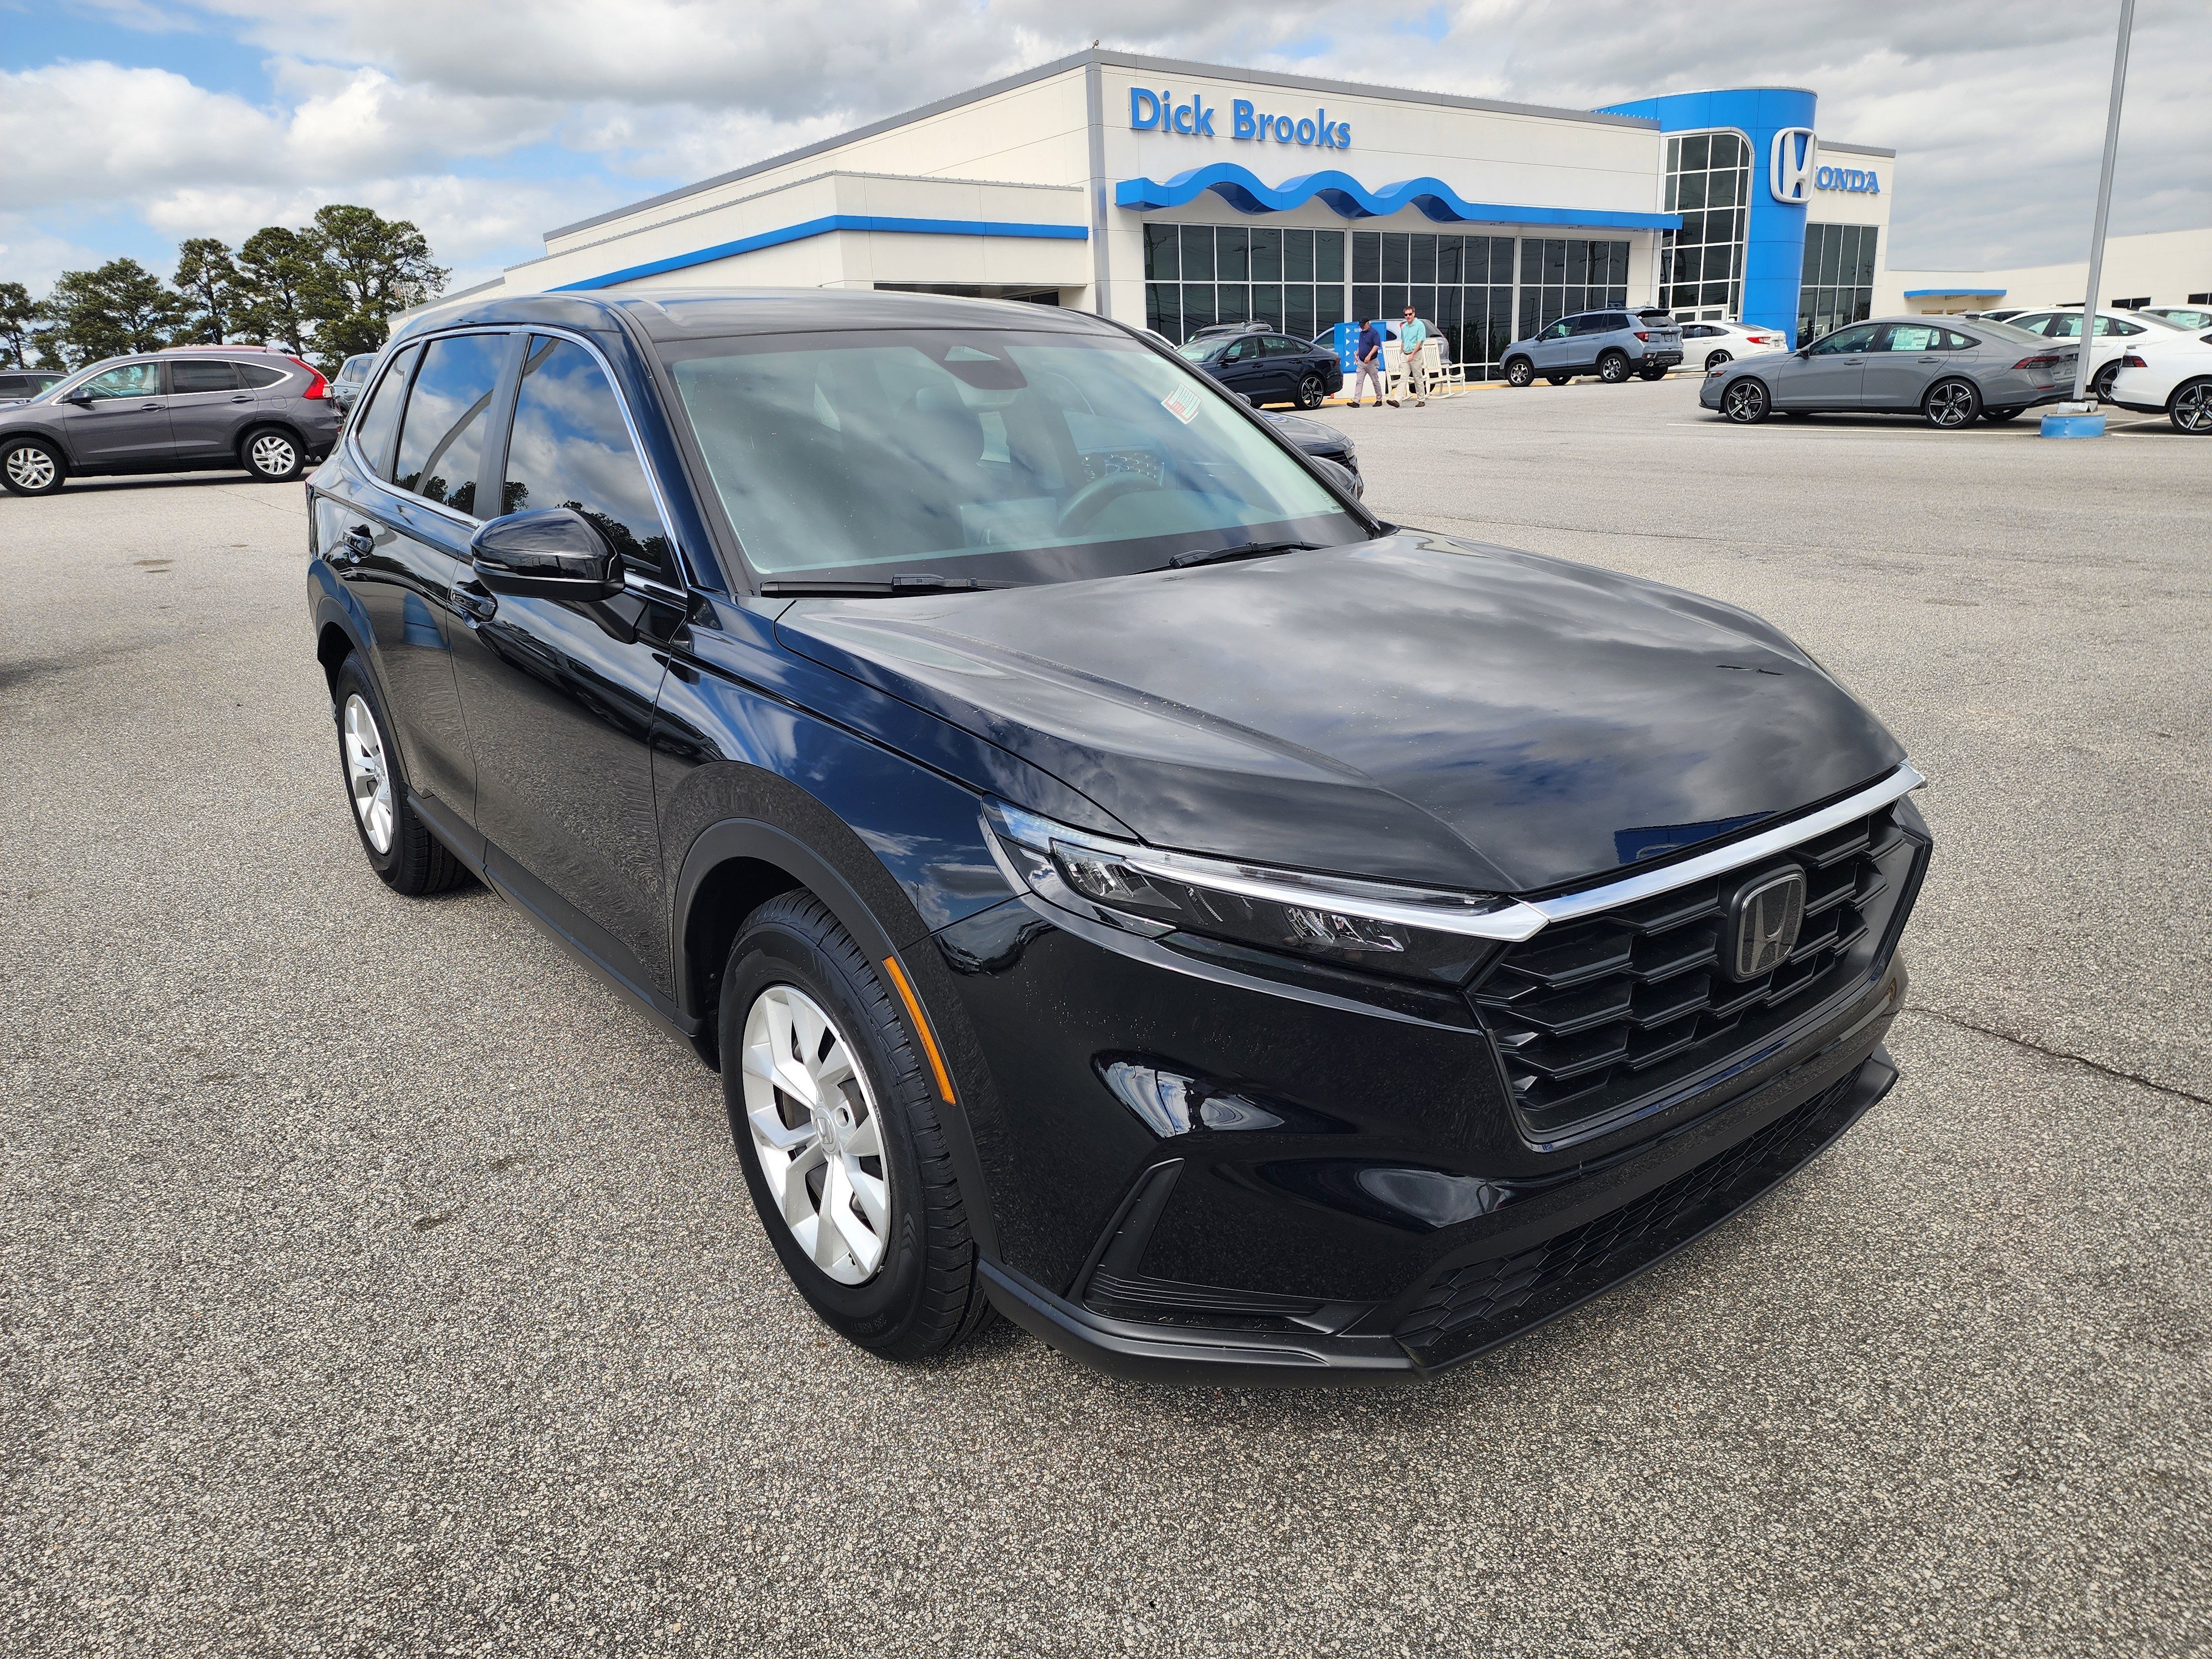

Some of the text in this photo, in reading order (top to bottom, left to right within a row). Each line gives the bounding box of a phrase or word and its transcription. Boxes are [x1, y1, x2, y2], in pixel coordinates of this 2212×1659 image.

[1129, 87, 1351, 148] Dick Brooks
[1815, 166, 1880, 193] ONDA
